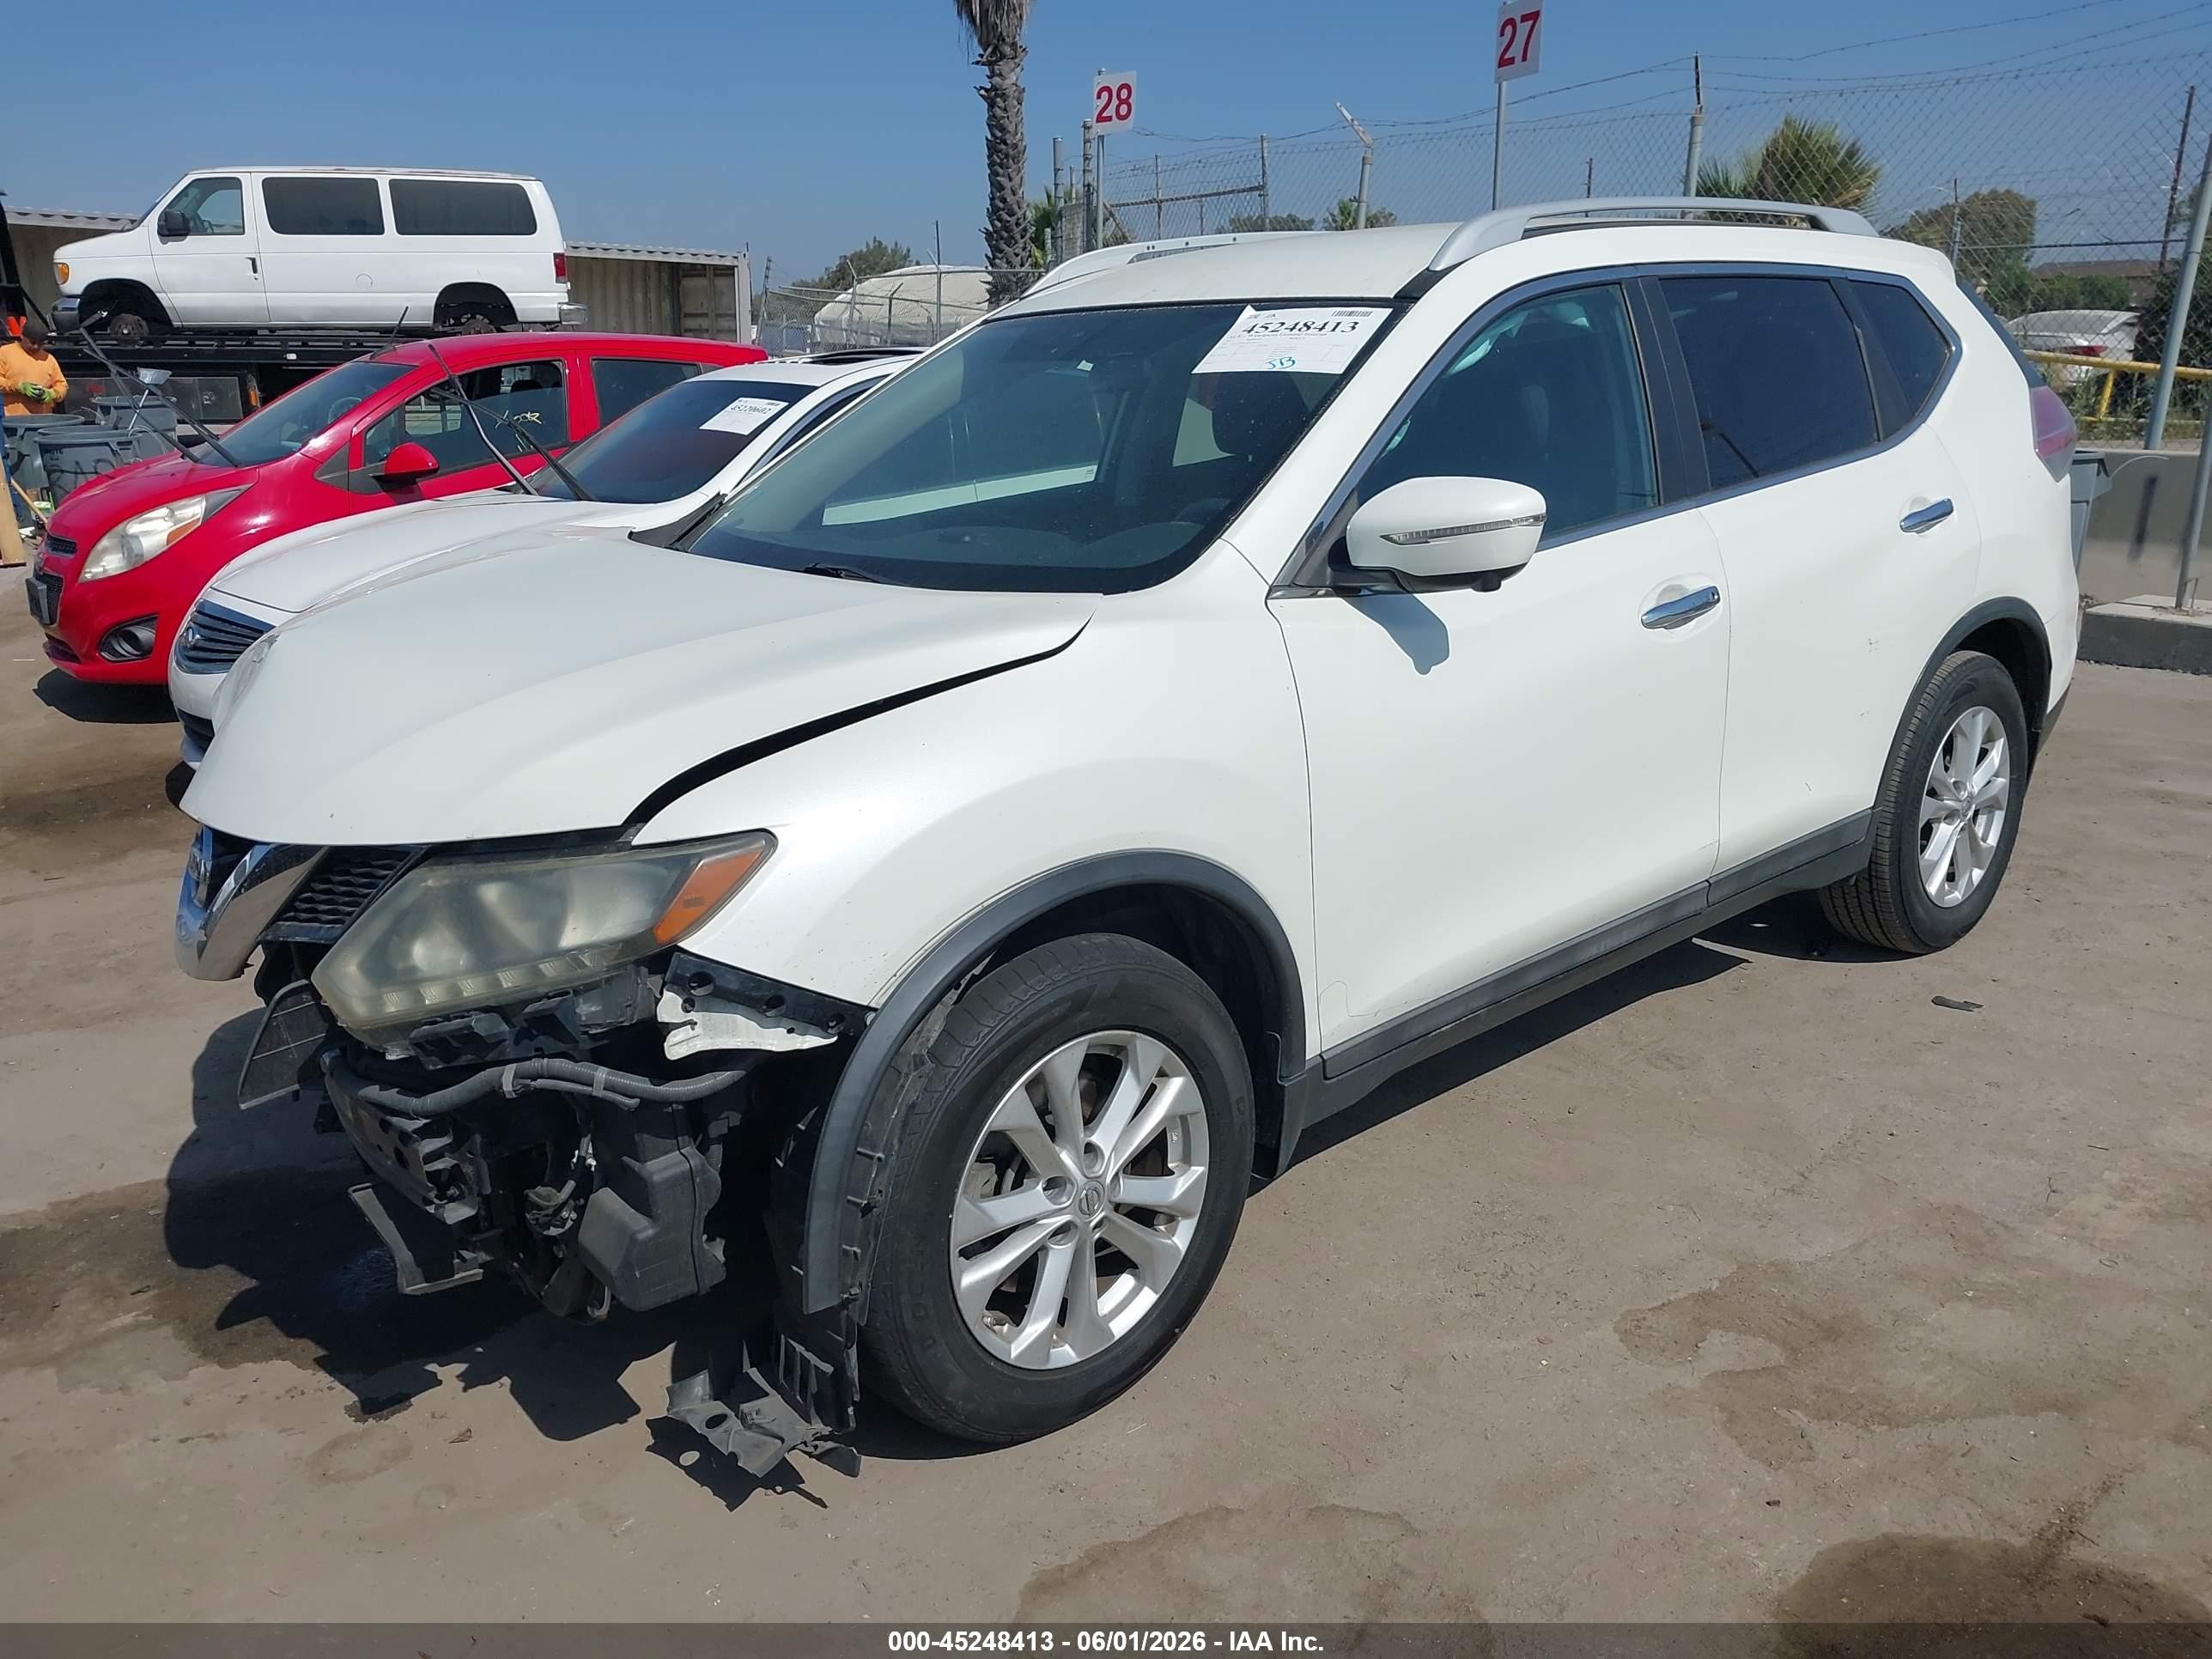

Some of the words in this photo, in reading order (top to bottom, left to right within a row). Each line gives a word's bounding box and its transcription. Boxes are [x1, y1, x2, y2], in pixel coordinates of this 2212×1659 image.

[1498, 9, 1540, 69] 27
[1096, 83, 1132, 123] 28
[1243, 321, 1359, 333] 45248413
